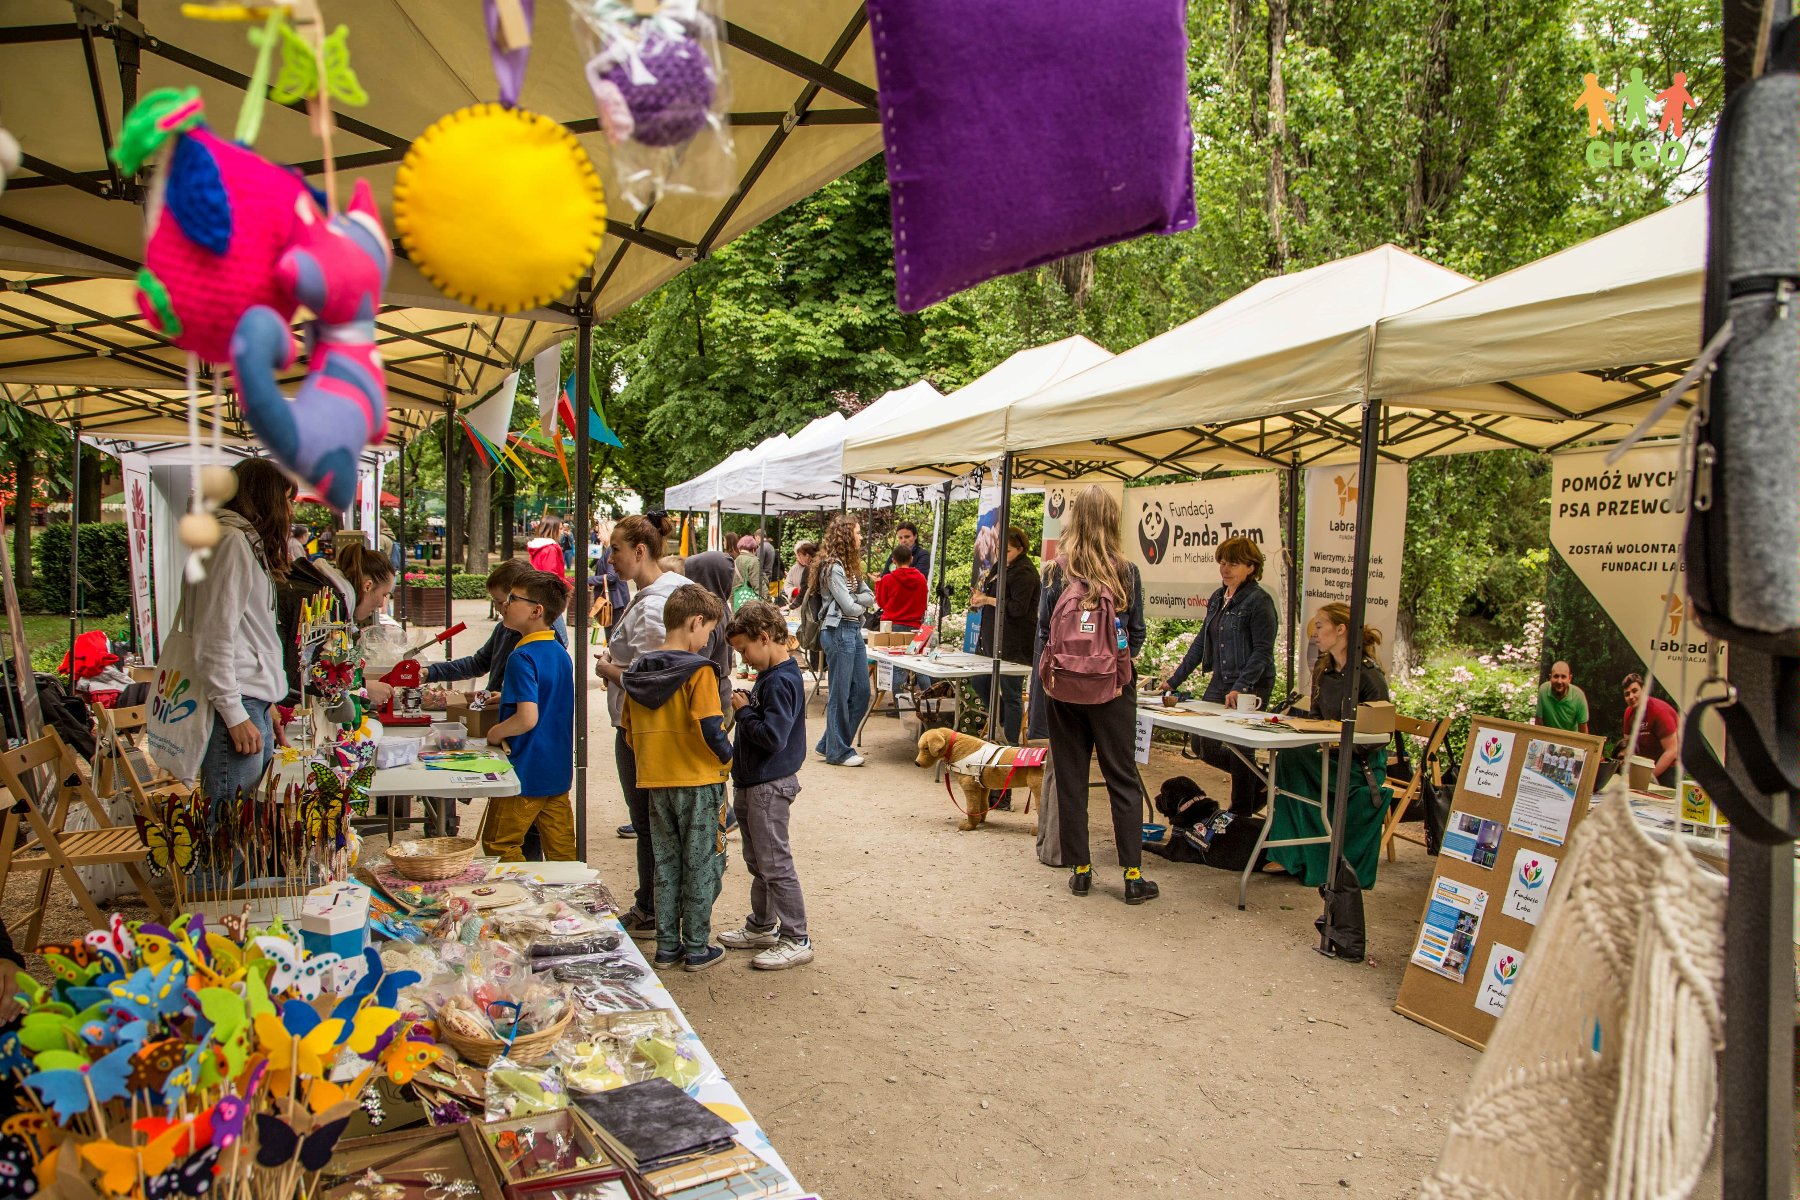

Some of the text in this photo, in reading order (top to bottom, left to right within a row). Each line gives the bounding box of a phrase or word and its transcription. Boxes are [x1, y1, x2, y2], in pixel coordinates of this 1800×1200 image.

[1561, 469, 1622, 493] POMÓŻ
[1169, 500, 1214, 519] Fundacja
[1559, 501, 1591, 518] PSA
[1173, 523, 1219, 547] Panda
[1568, 542, 1613, 555] ZOSTAŃ
[1313, 551, 1347, 564] Wierzymy,
[1309, 564, 1321, 573] ma
[1322, 566, 1340, 577] prawo
[1341, 566, 1350, 576] do
[1601, 561, 1658, 572] FUNDACJI
[1324, 577, 1336, 587] bez
[1149, 593, 1186, 609] oswajamy
